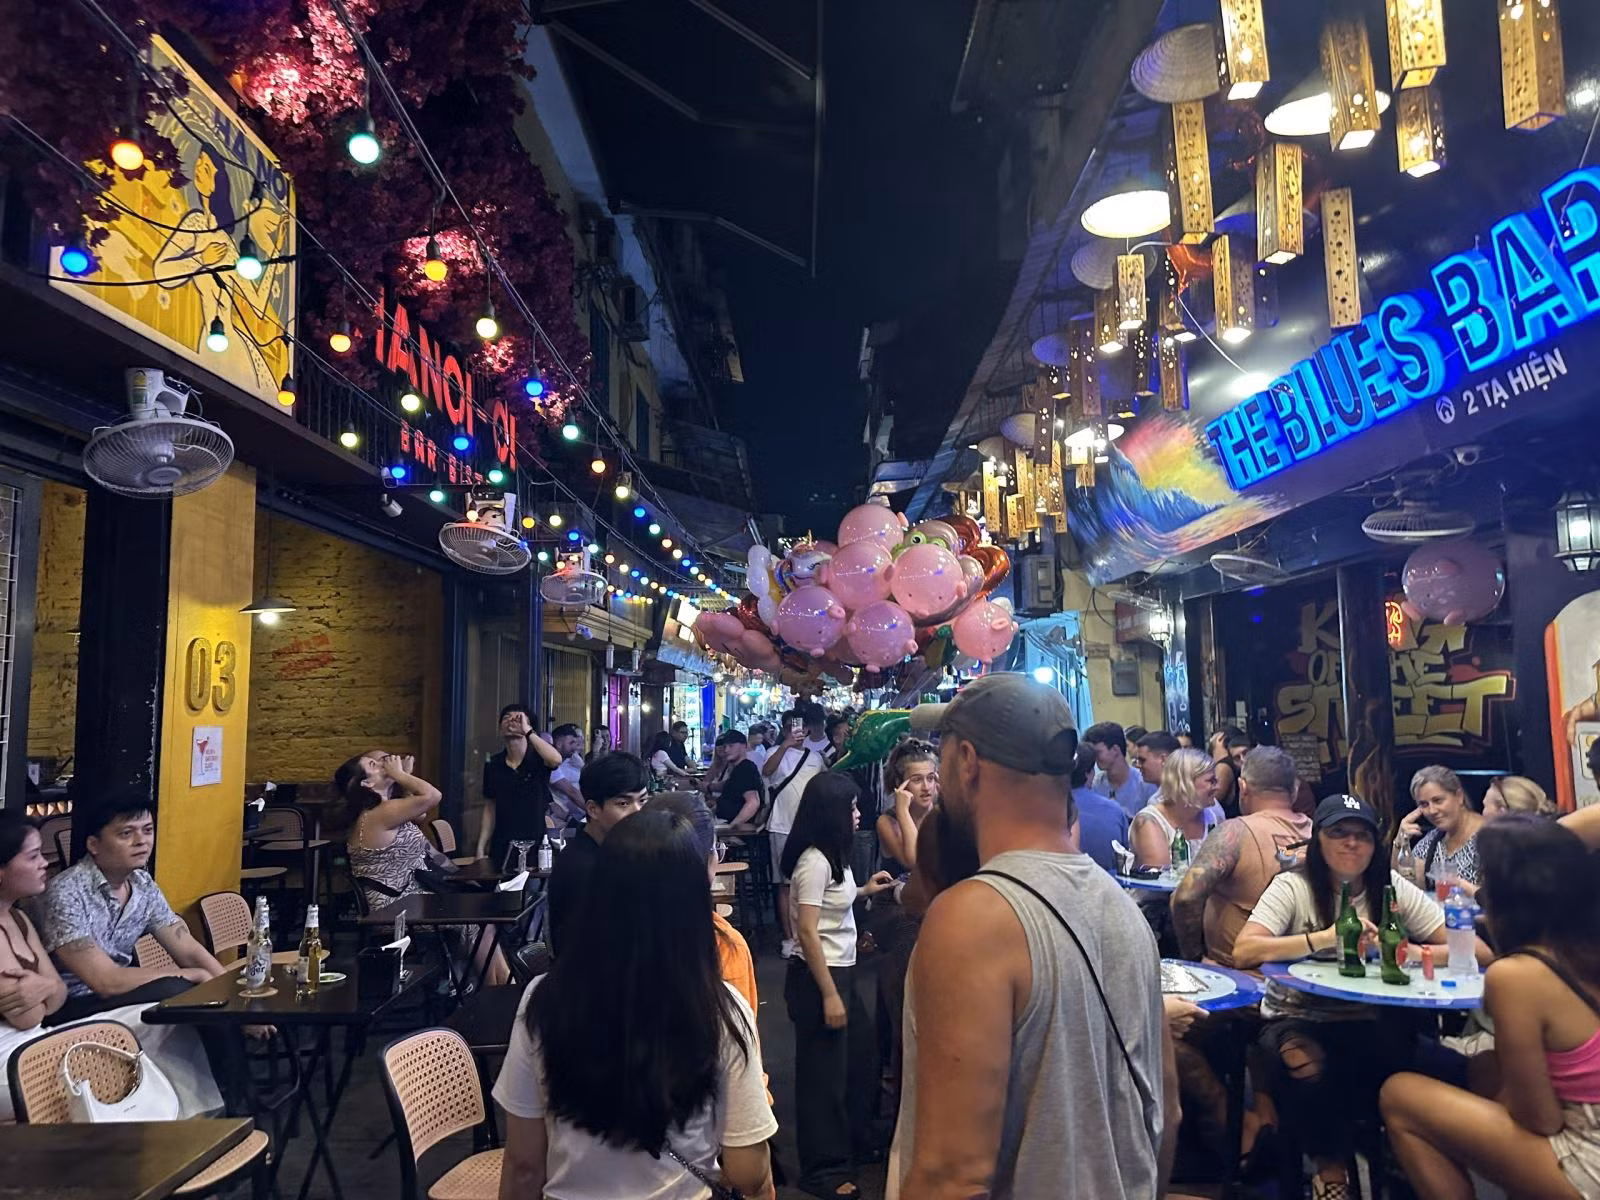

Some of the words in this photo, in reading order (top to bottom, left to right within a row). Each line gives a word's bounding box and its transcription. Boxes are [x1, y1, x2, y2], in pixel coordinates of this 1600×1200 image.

[1205, 396, 1284, 490] THE
[1269, 294, 1437, 462] BLUES
[1431, 166, 1600, 372] BAR
[1463, 389, 1479, 415] 2
[1477, 377, 1507, 409] TẠ
[1506, 347, 1568, 395] HIỆN
[401, 418, 437, 473] BAR
[185, 637, 236, 712] 03
[1308, 650, 1342, 686] OF
[1278, 675, 1507, 765] STEET
[1341, 794, 1360, 809] LA
